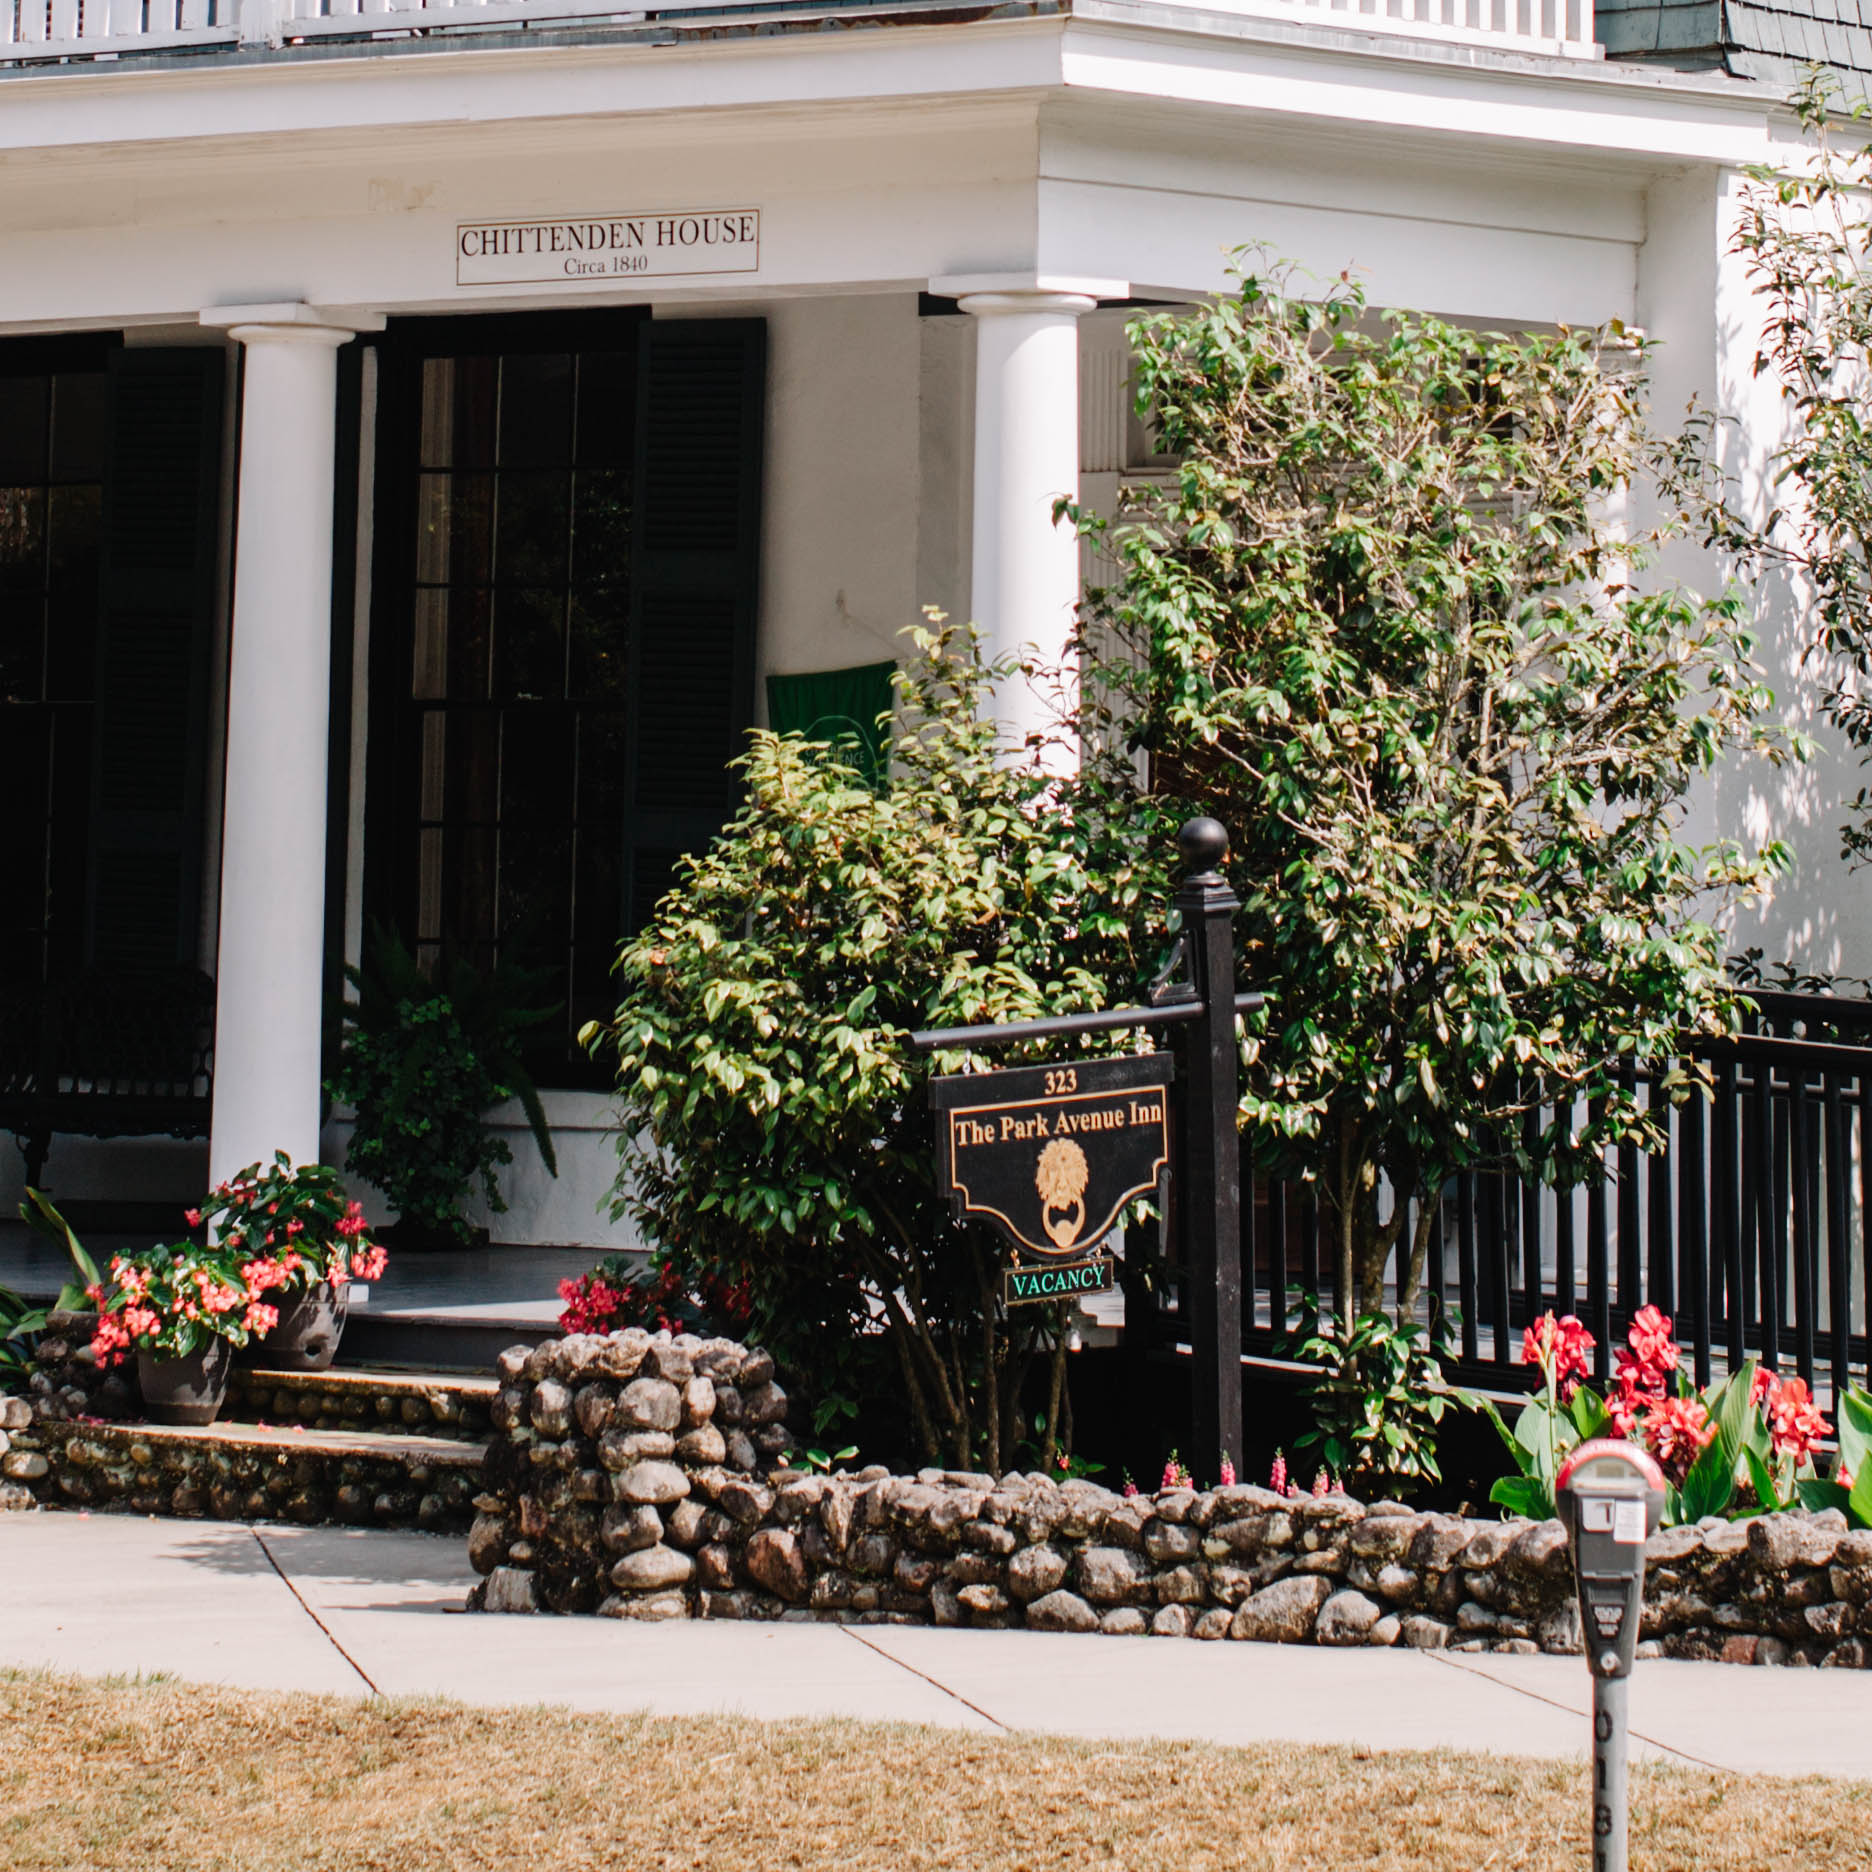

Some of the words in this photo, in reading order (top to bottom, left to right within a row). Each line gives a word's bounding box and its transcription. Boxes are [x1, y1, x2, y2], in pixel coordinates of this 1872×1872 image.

[461, 222, 645, 257] CHITTENDEN
[656, 216, 755, 247] HOUSE
[564, 258, 605, 275] Circa
[612, 255, 648, 273] 1840
[1044, 1069, 1077, 1095] 323
[955, 1120, 995, 1146] The
[1000, 1113, 1049, 1141] Park
[1053, 1109, 1124, 1135] Avenue
[1130, 1101, 1162, 1125] Inn
[1012, 1266, 1105, 1296] VACANCY
